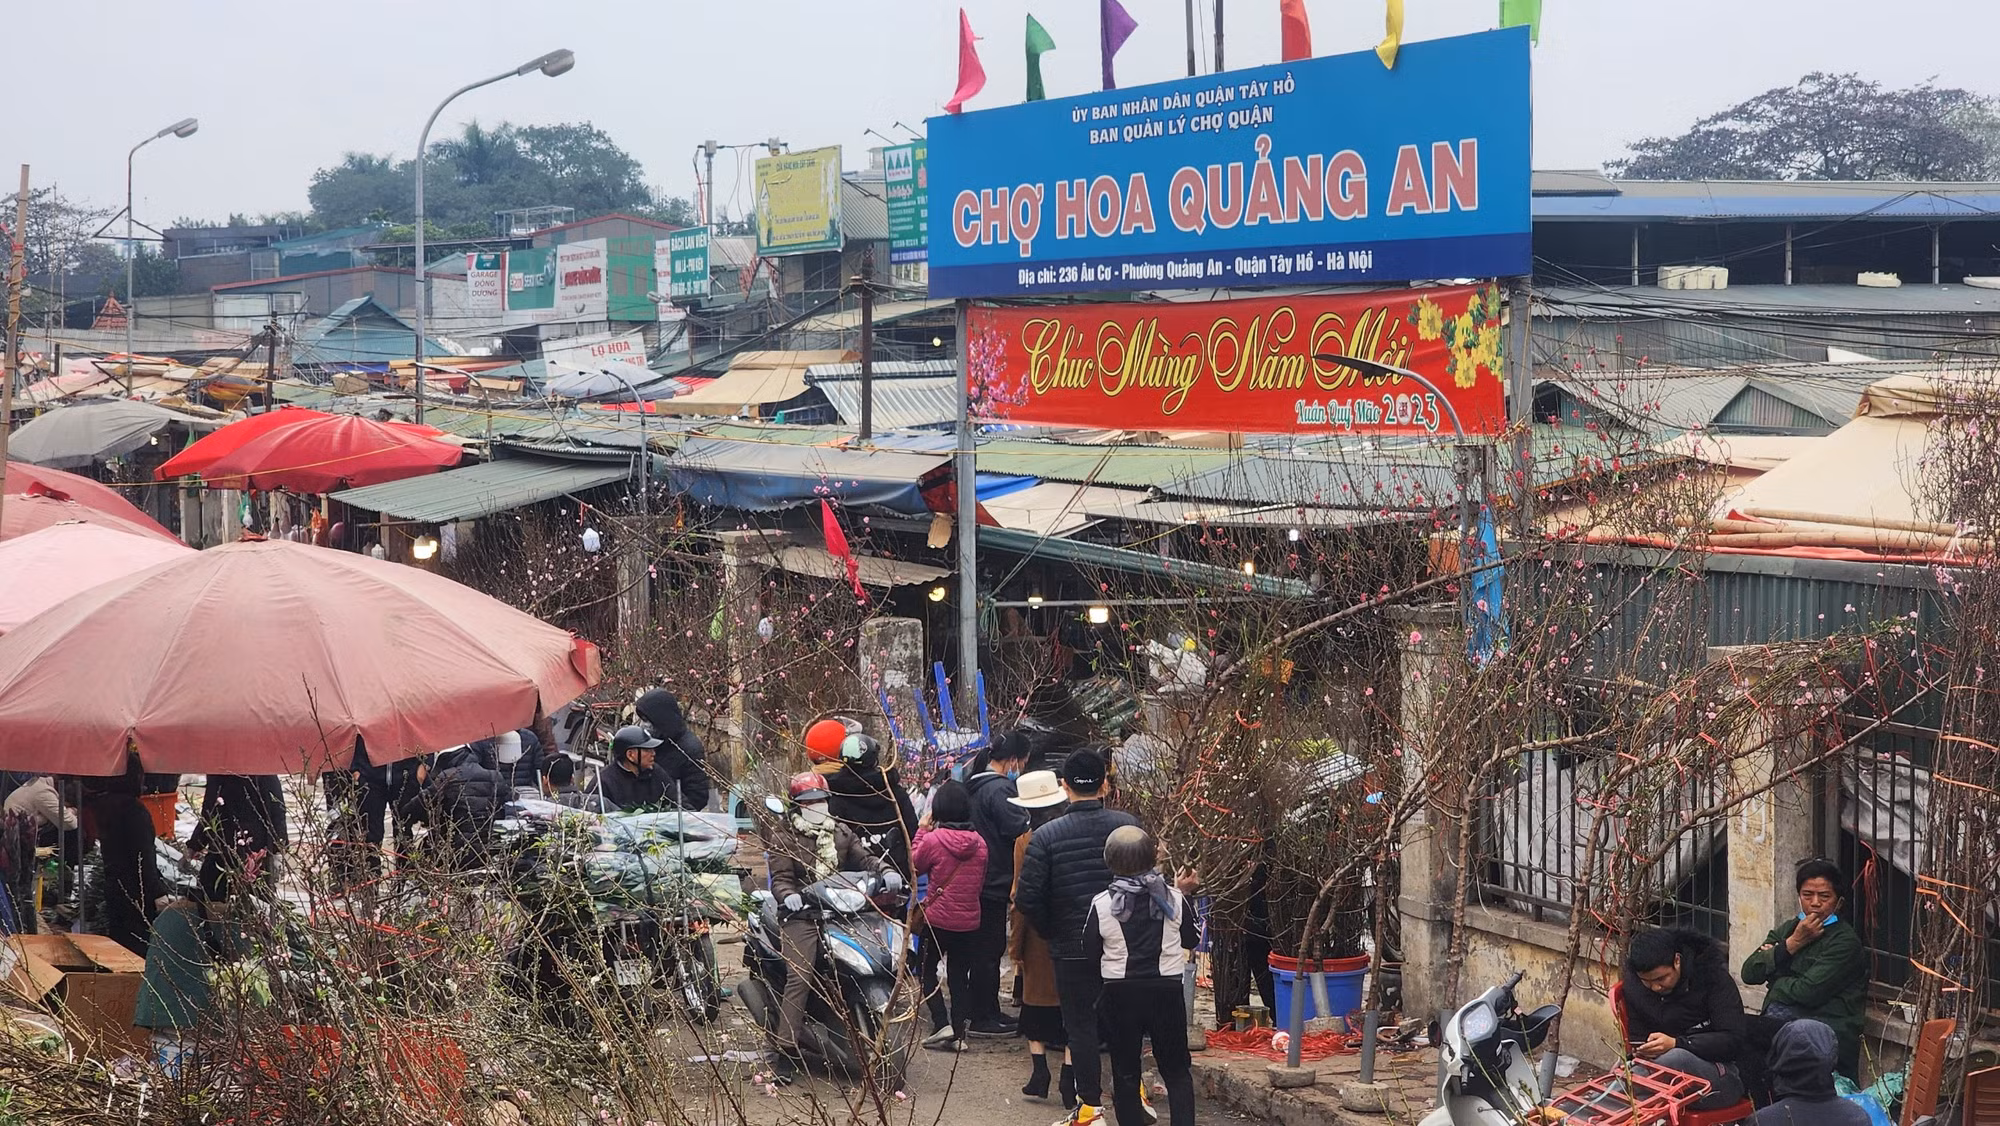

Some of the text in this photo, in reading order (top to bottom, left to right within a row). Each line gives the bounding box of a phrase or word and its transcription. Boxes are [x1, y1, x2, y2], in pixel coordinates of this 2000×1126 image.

[1072, 71, 1295, 123] ỦY BAN NHÂN DÂN QUẬN TÂY HỒ
[1089, 104, 1273, 145] BAN QUẢN LÝ CHỢ QUẬN
[953, 133, 1478, 258] CHỢ HOA QUẢNG AN
[474, 279, 495, 287] ĐÔNG
[1018, 268, 1035, 288] Địa
[1037, 265, 1056, 284] chỉ:
[1058, 266, 1078, 283] 236
[1080, 262, 1094, 282] Âu
[1096, 264, 1112, 281] Cơ
[1121, 261, 1163, 281] Phường
[1167, 258, 1203, 279] Quảng
[1206, 258, 1222, 276] An
[1234, 256, 1266, 277] Quận
[1270, 254, 1292, 275] Tây
[1296, 250, 1314, 271] Hồ
[1326, 251, 1344, 271] Hà
[1349, 250, 1372, 273] Nội
[471, 289, 498, 297] DƯƠNG
[591, 341, 631, 358] LỌ HOA
[1022, 306, 1414, 414] Chúc Mừng Năm Mới
[1295, 399, 1326, 424] Xuân
[1328, 399, 1352, 430] Quý
[1355, 399, 1381, 424] Mão
